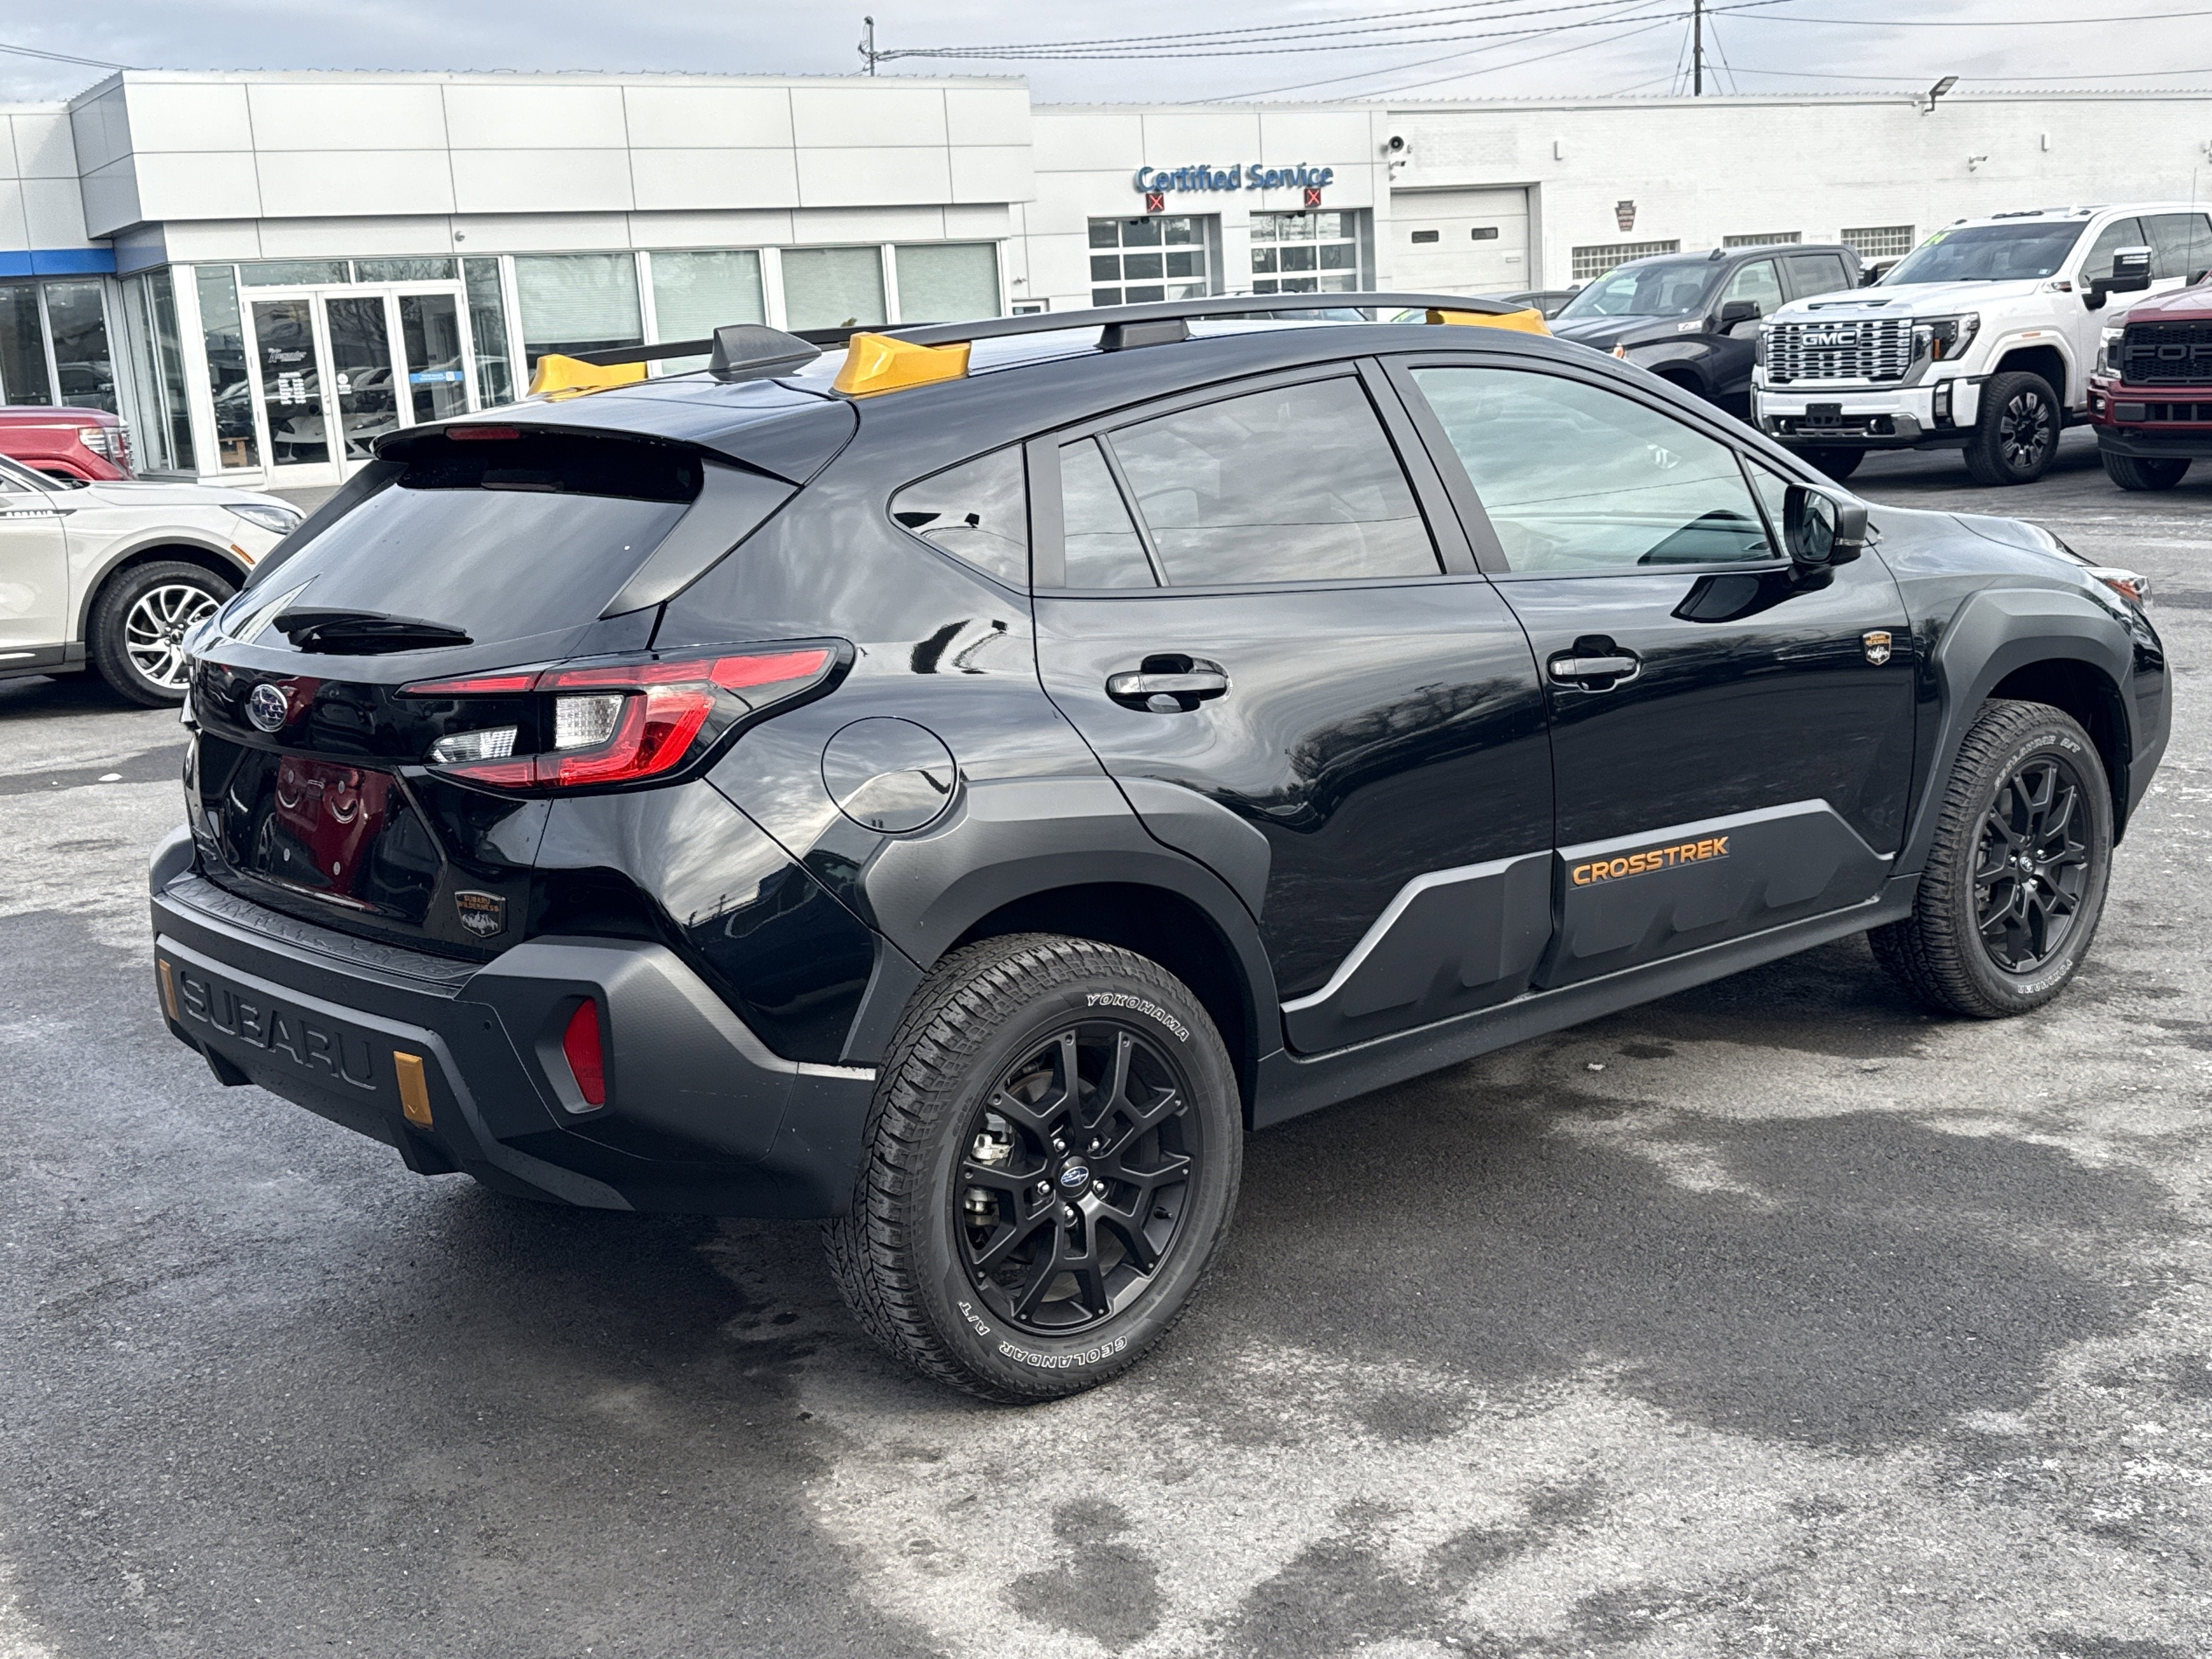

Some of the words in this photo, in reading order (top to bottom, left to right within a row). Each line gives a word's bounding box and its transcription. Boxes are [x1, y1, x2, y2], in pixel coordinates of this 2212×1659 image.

[1135, 164, 1242, 193] Certified
[1245, 162, 1334, 190] Service
[1802, 332, 1855, 346] GMC
[1572, 836, 1729, 886] CROSSTREK
[179, 970, 377, 1091] SUBARU
[1086, 992, 1190, 1043] YOKOHAMA
[957, 1301, 991, 1336] A/T
[998, 1335, 1127, 1369] GEOLANDAR
